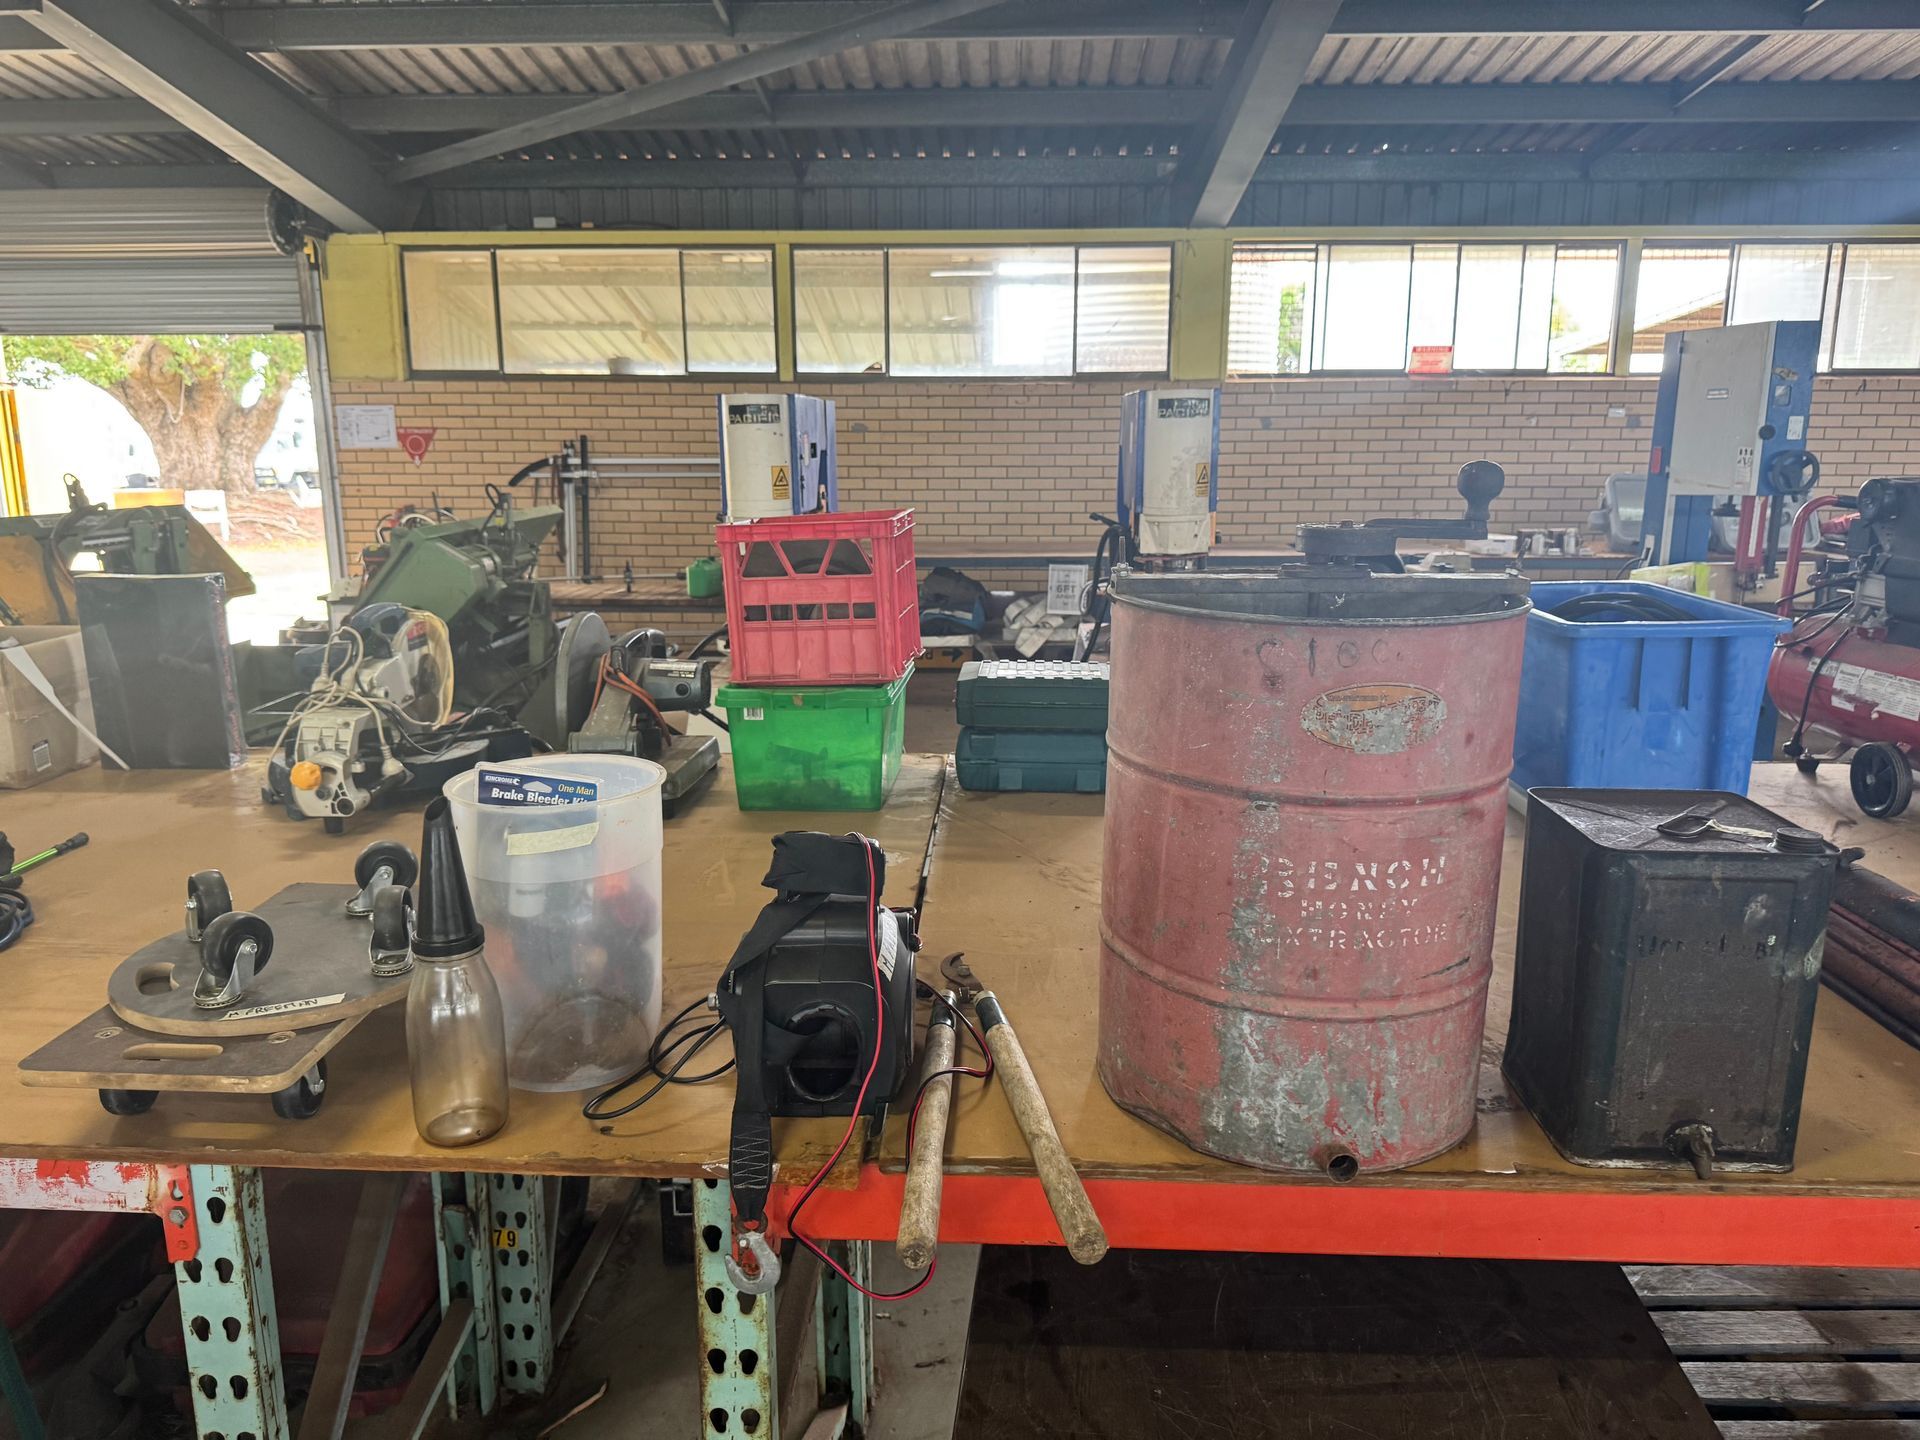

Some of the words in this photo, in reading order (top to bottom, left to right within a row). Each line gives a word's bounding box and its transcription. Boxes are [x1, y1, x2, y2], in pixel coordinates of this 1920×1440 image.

[491, 787, 525, 801] Brake
[526, 791, 570, 804] Bleeder
[558, 783, 574, 792] One
[576, 786, 595, 796] Man
[494, 1229, 516, 1248] 79
